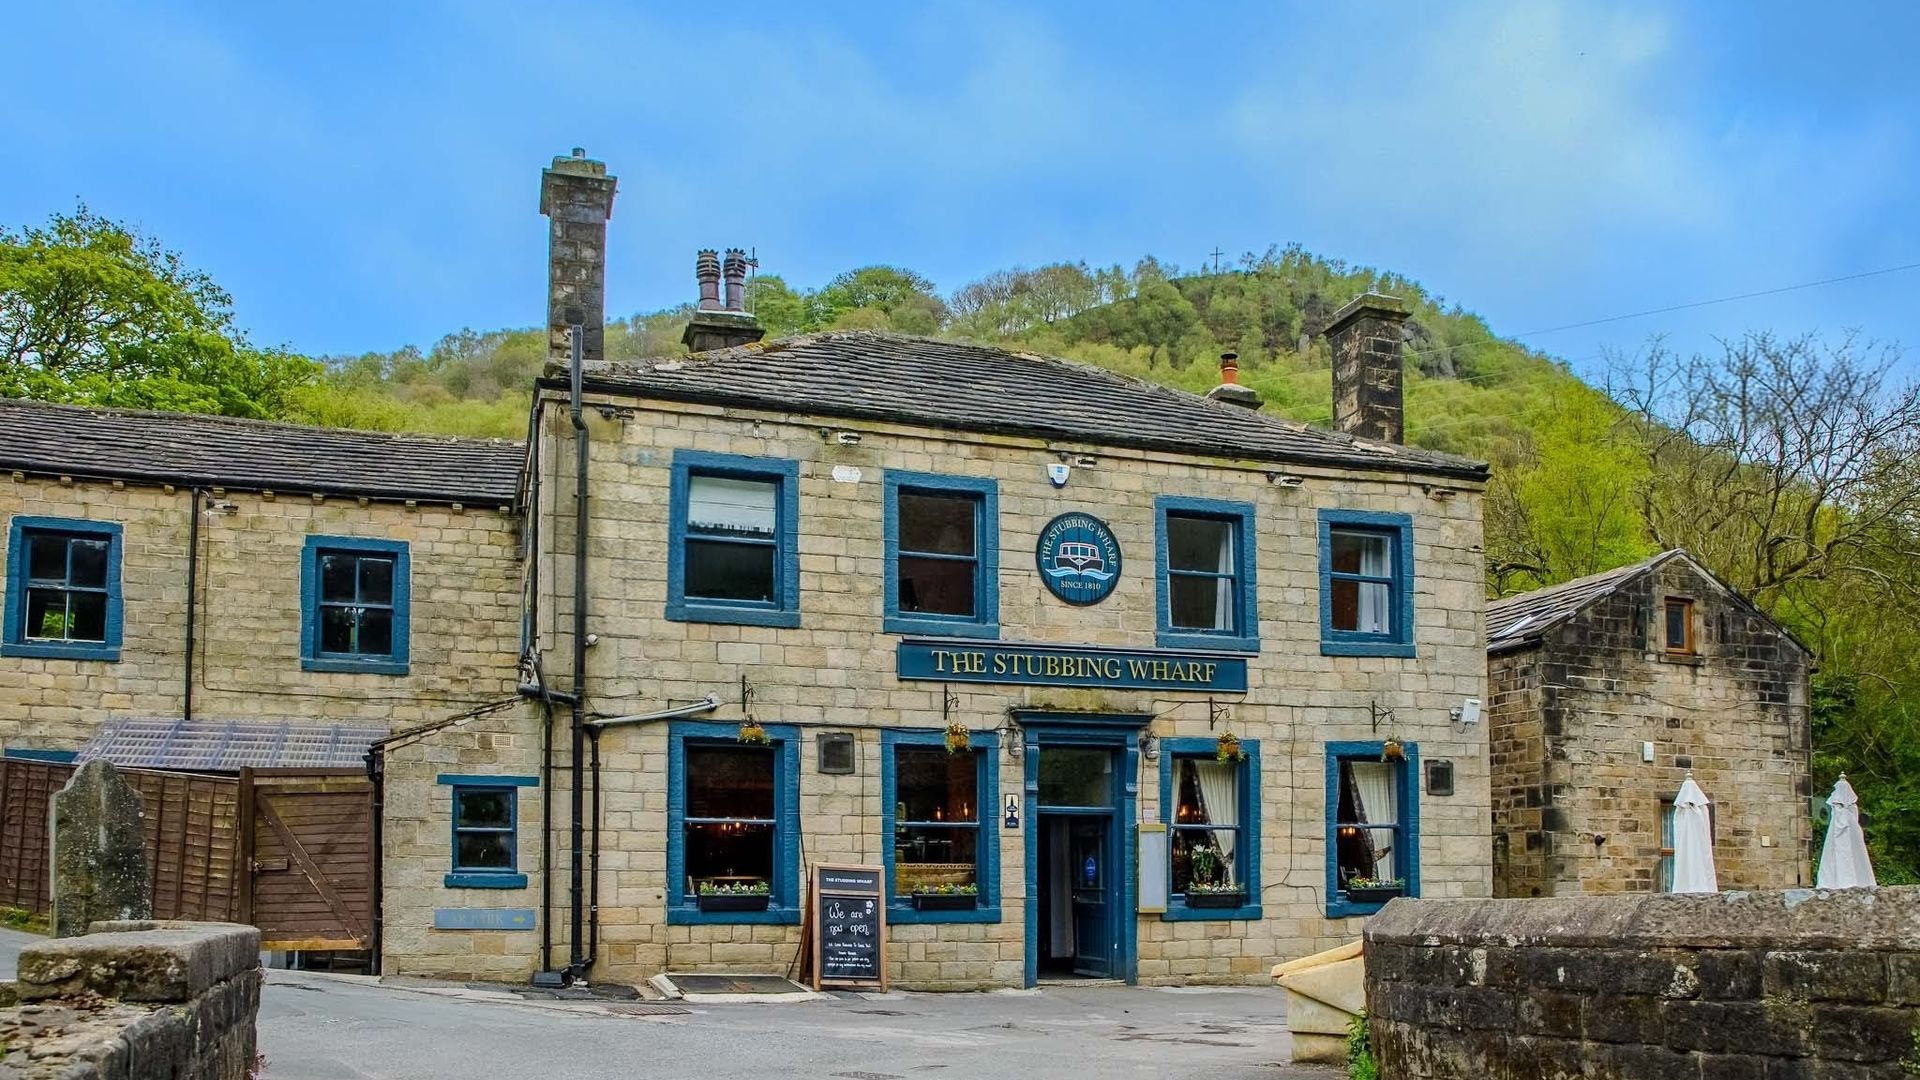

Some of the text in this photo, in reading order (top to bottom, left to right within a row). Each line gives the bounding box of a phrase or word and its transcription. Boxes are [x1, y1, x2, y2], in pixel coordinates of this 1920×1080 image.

[1043, 519, 1116, 567] THE STUBBING WHARF
[1060, 580, 1101, 590] SINCE 1810
[931, 650, 1217, 683] THE STUBBING WHARF
[829, 902, 863, 919] We are
[829, 924, 870, 936] now open
